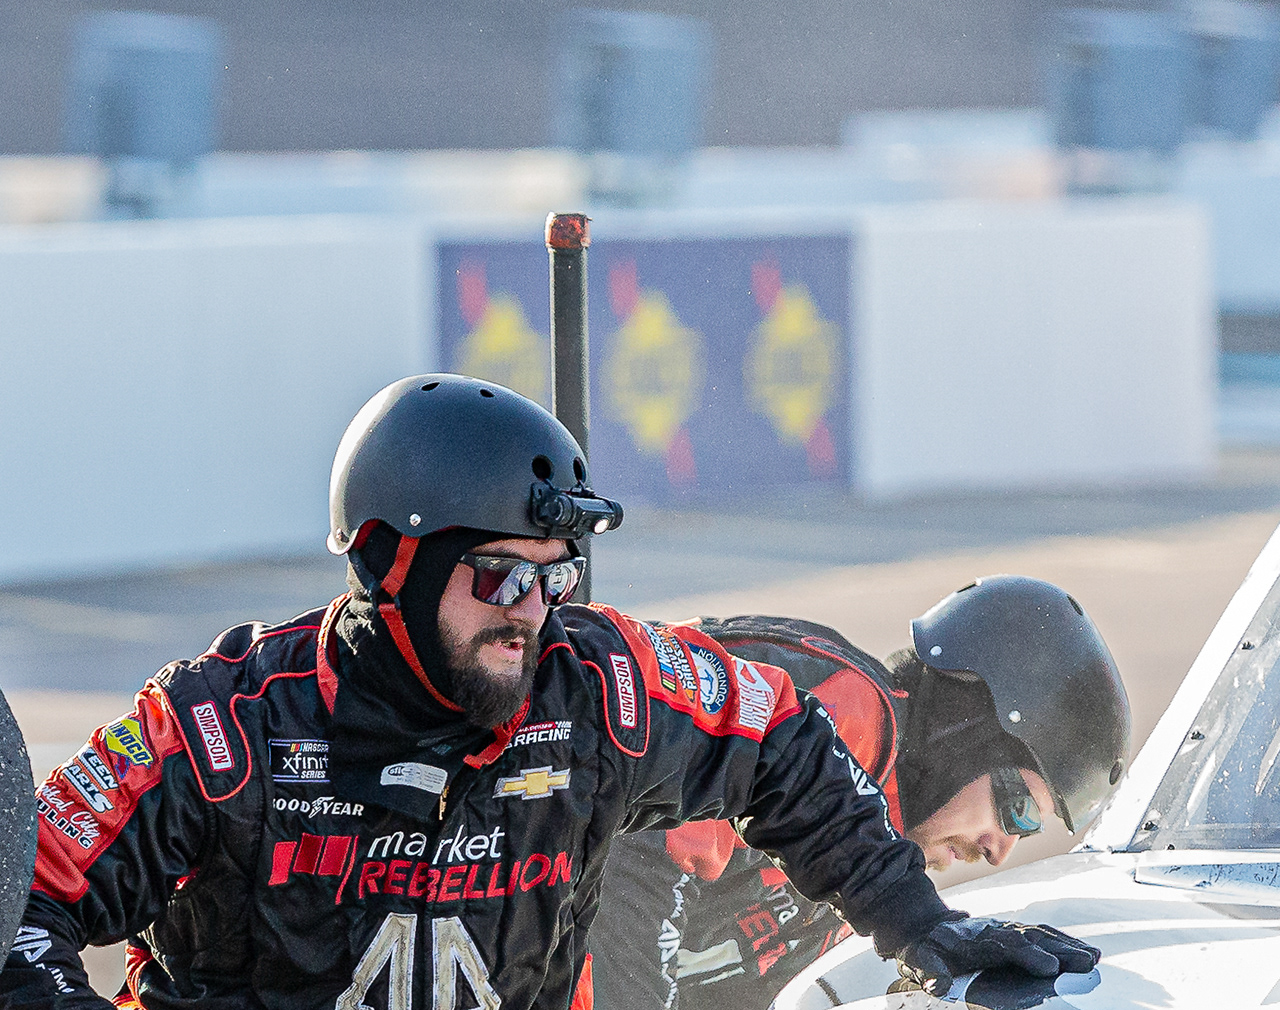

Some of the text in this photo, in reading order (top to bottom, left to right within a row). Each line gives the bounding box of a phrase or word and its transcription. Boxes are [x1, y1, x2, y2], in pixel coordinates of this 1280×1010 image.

[613, 659, 634, 723] SIMPSON
[697, 648, 728, 706] FOUNDATION
[108, 723, 150, 763] NOCO
[196, 707, 229, 764] SIMPSON
[514, 728, 571, 747] RACING
[282, 753, 329, 774] xfinit
[301, 770, 326, 779] SERIES
[40, 785, 74, 812] pital
[67, 764, 114, 813] ARTS
[37, 798, 94, 849] ULING
[367, 824, 506, 864] market
[358, 850, 573, 903] REBELLION
